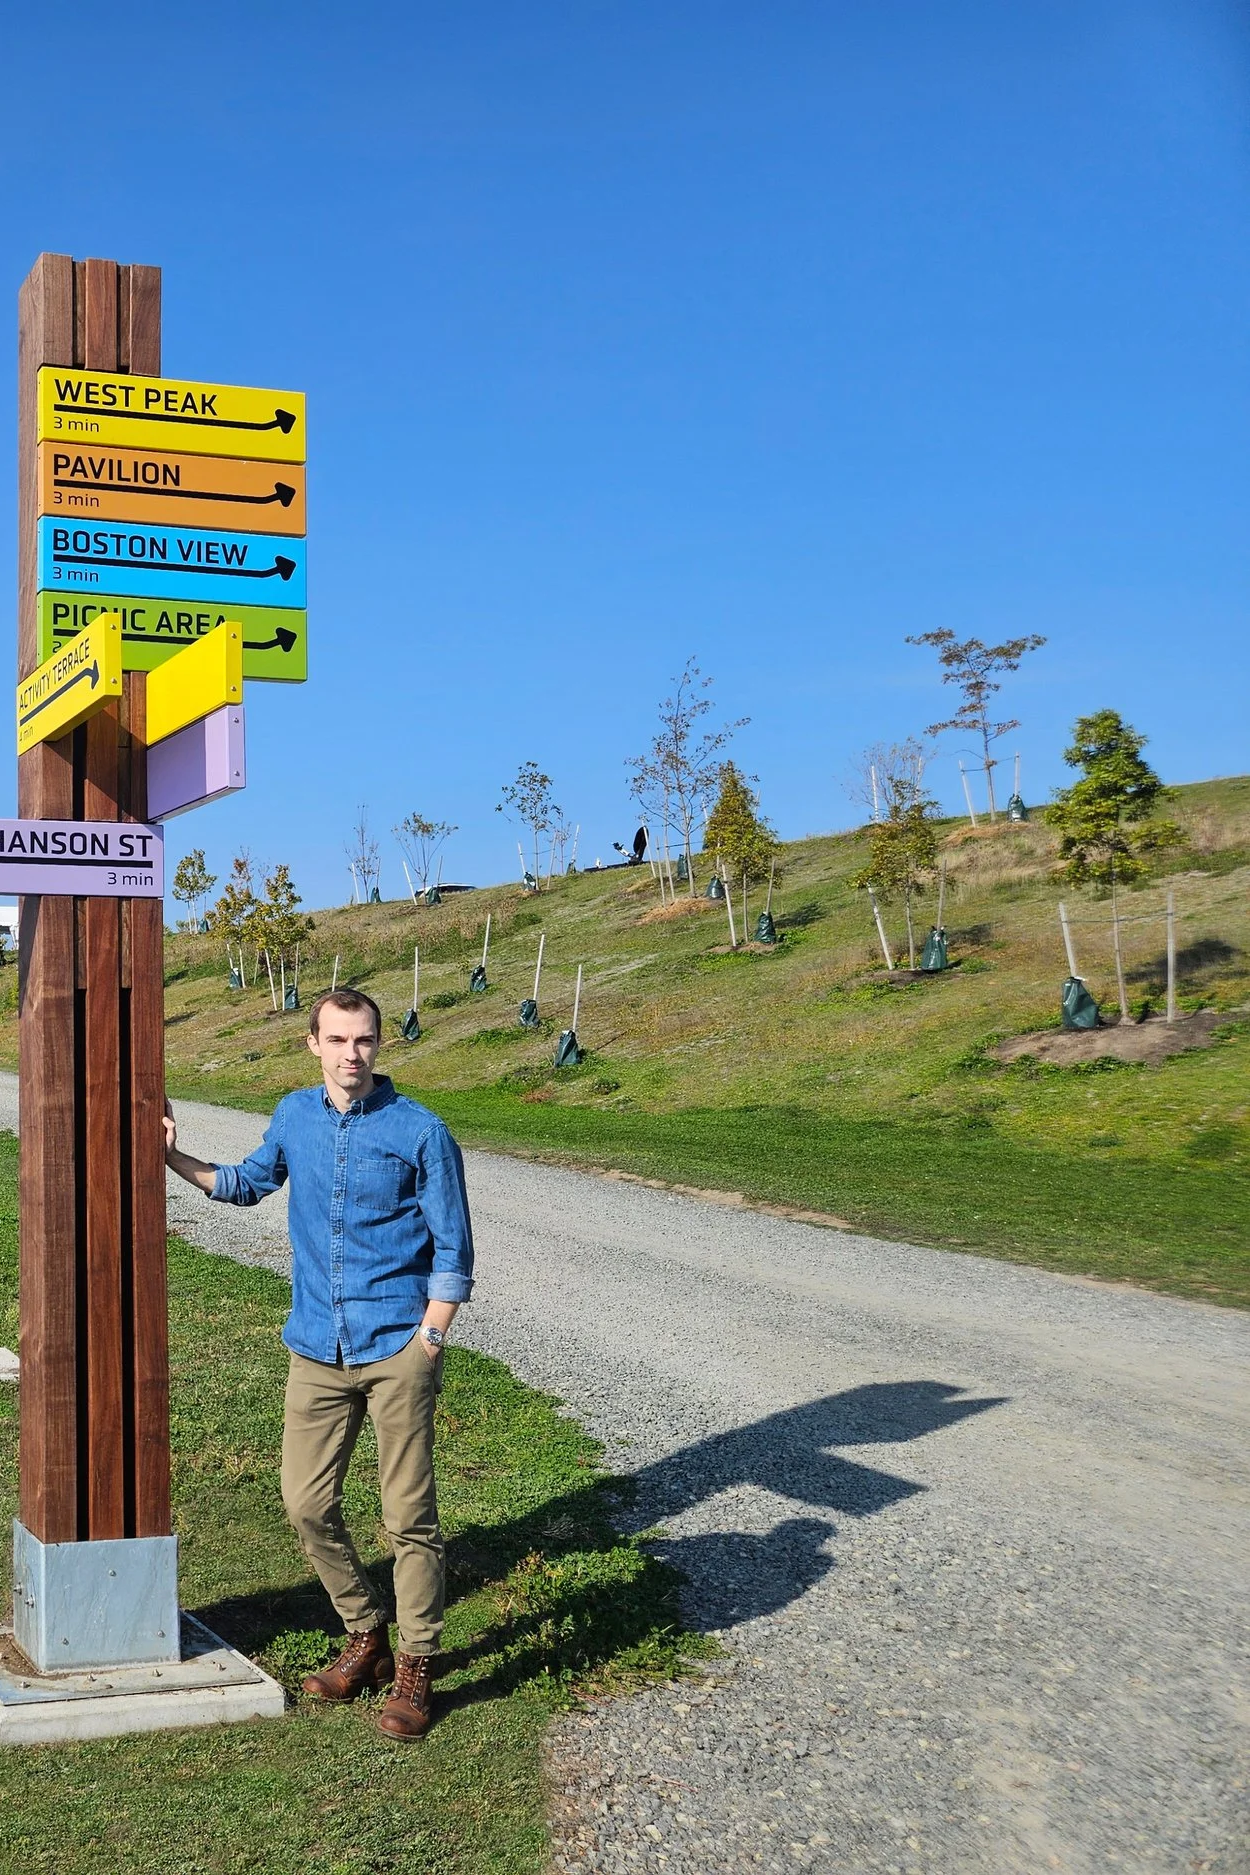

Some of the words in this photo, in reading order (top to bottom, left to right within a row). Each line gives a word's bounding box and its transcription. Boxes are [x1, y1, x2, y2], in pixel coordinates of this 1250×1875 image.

[54, 379, 135, 407] WEST
[145, 388, 218, 416] PEAK
[54, 416, 63, 429] 3
[68, 418, 100, 433] min
[53, 454, 180, 487] PAVILION
[54, 491, 63, 504] 3
[68, 493, 100, 508] min
[53, 528, 167, 560] BOSTON
[176, 539, 248, 566] VIEW
[53, 567, 62, 580] 3
[67, 569, 99, 583] min
[53, 603, 146, 632] PICIC
[19, 669, 51, 713] ACTIVITY
[52, 637, 90, 685] TERRACE
[119, 834, 154, 857] ST
[107, 872, 117, 886] 3
[123, 872, 154, 886] min
